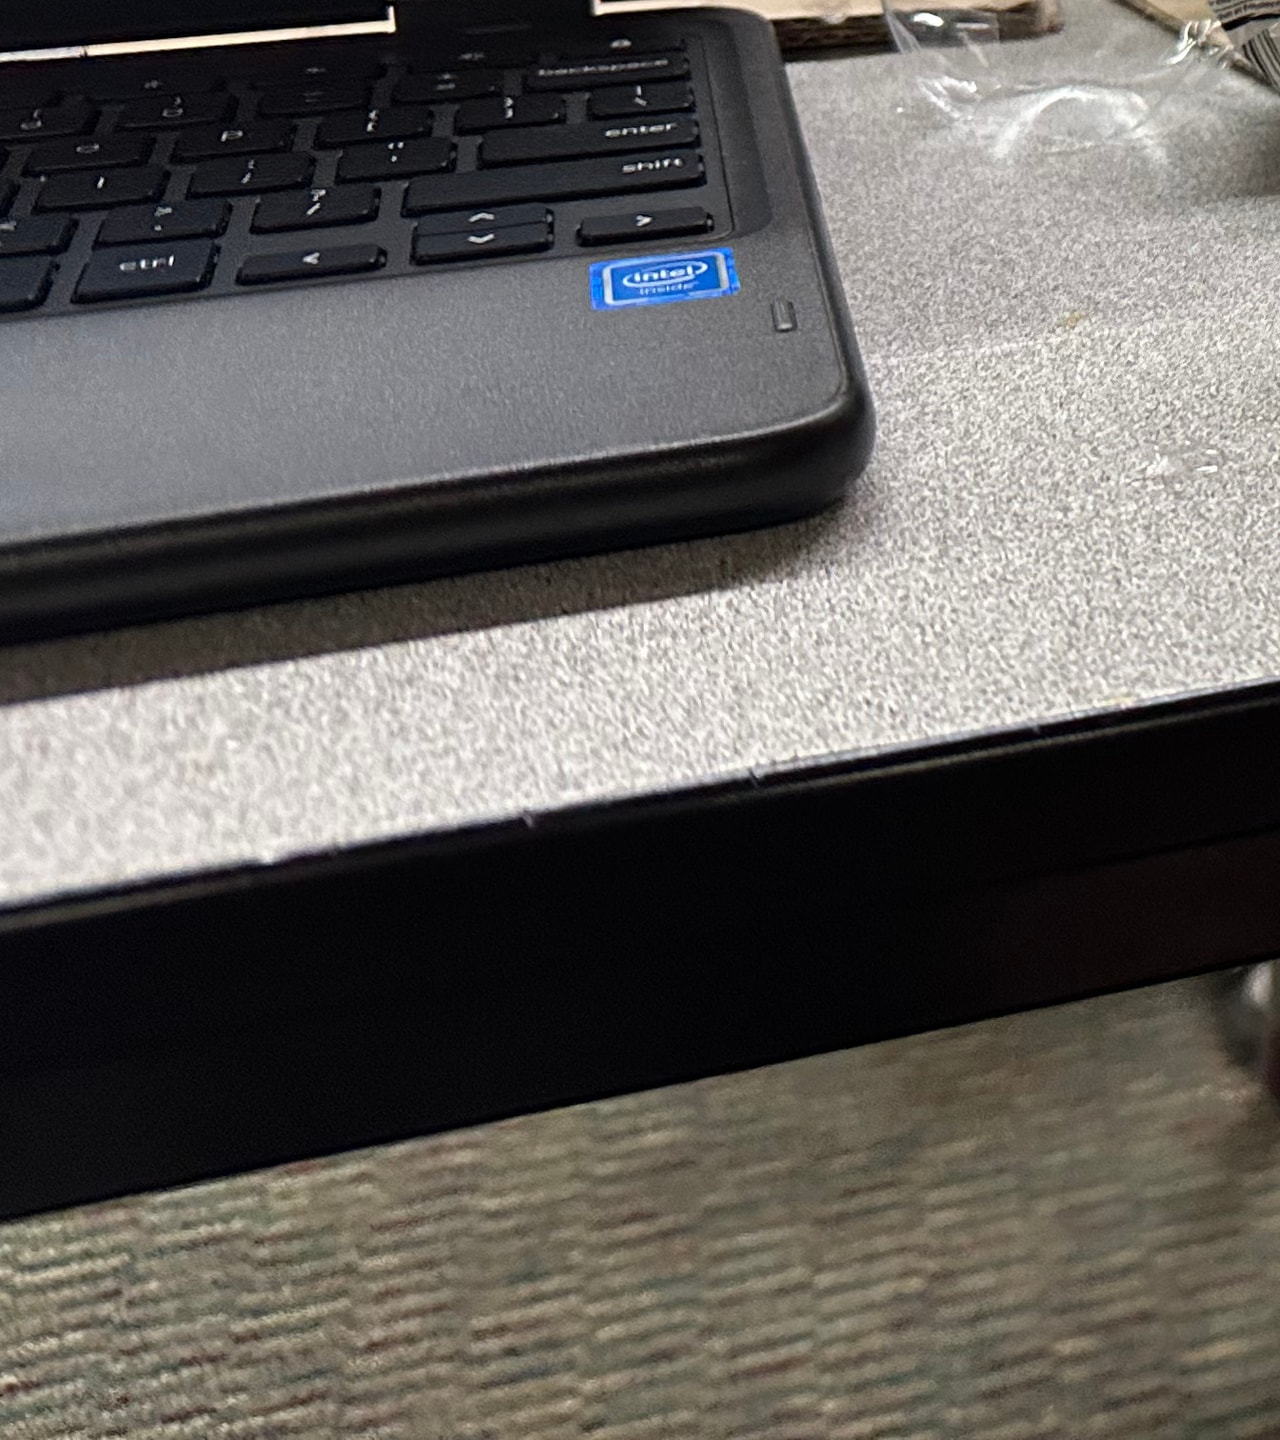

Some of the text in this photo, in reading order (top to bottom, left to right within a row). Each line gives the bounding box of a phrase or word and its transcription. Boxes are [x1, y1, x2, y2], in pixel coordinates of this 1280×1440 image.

[604, 122, 679, 138] enter
[622, 158, 684, 174] shift
[119, 256, 175, 271] ctrl
[634, 265, 693, 282] intel
